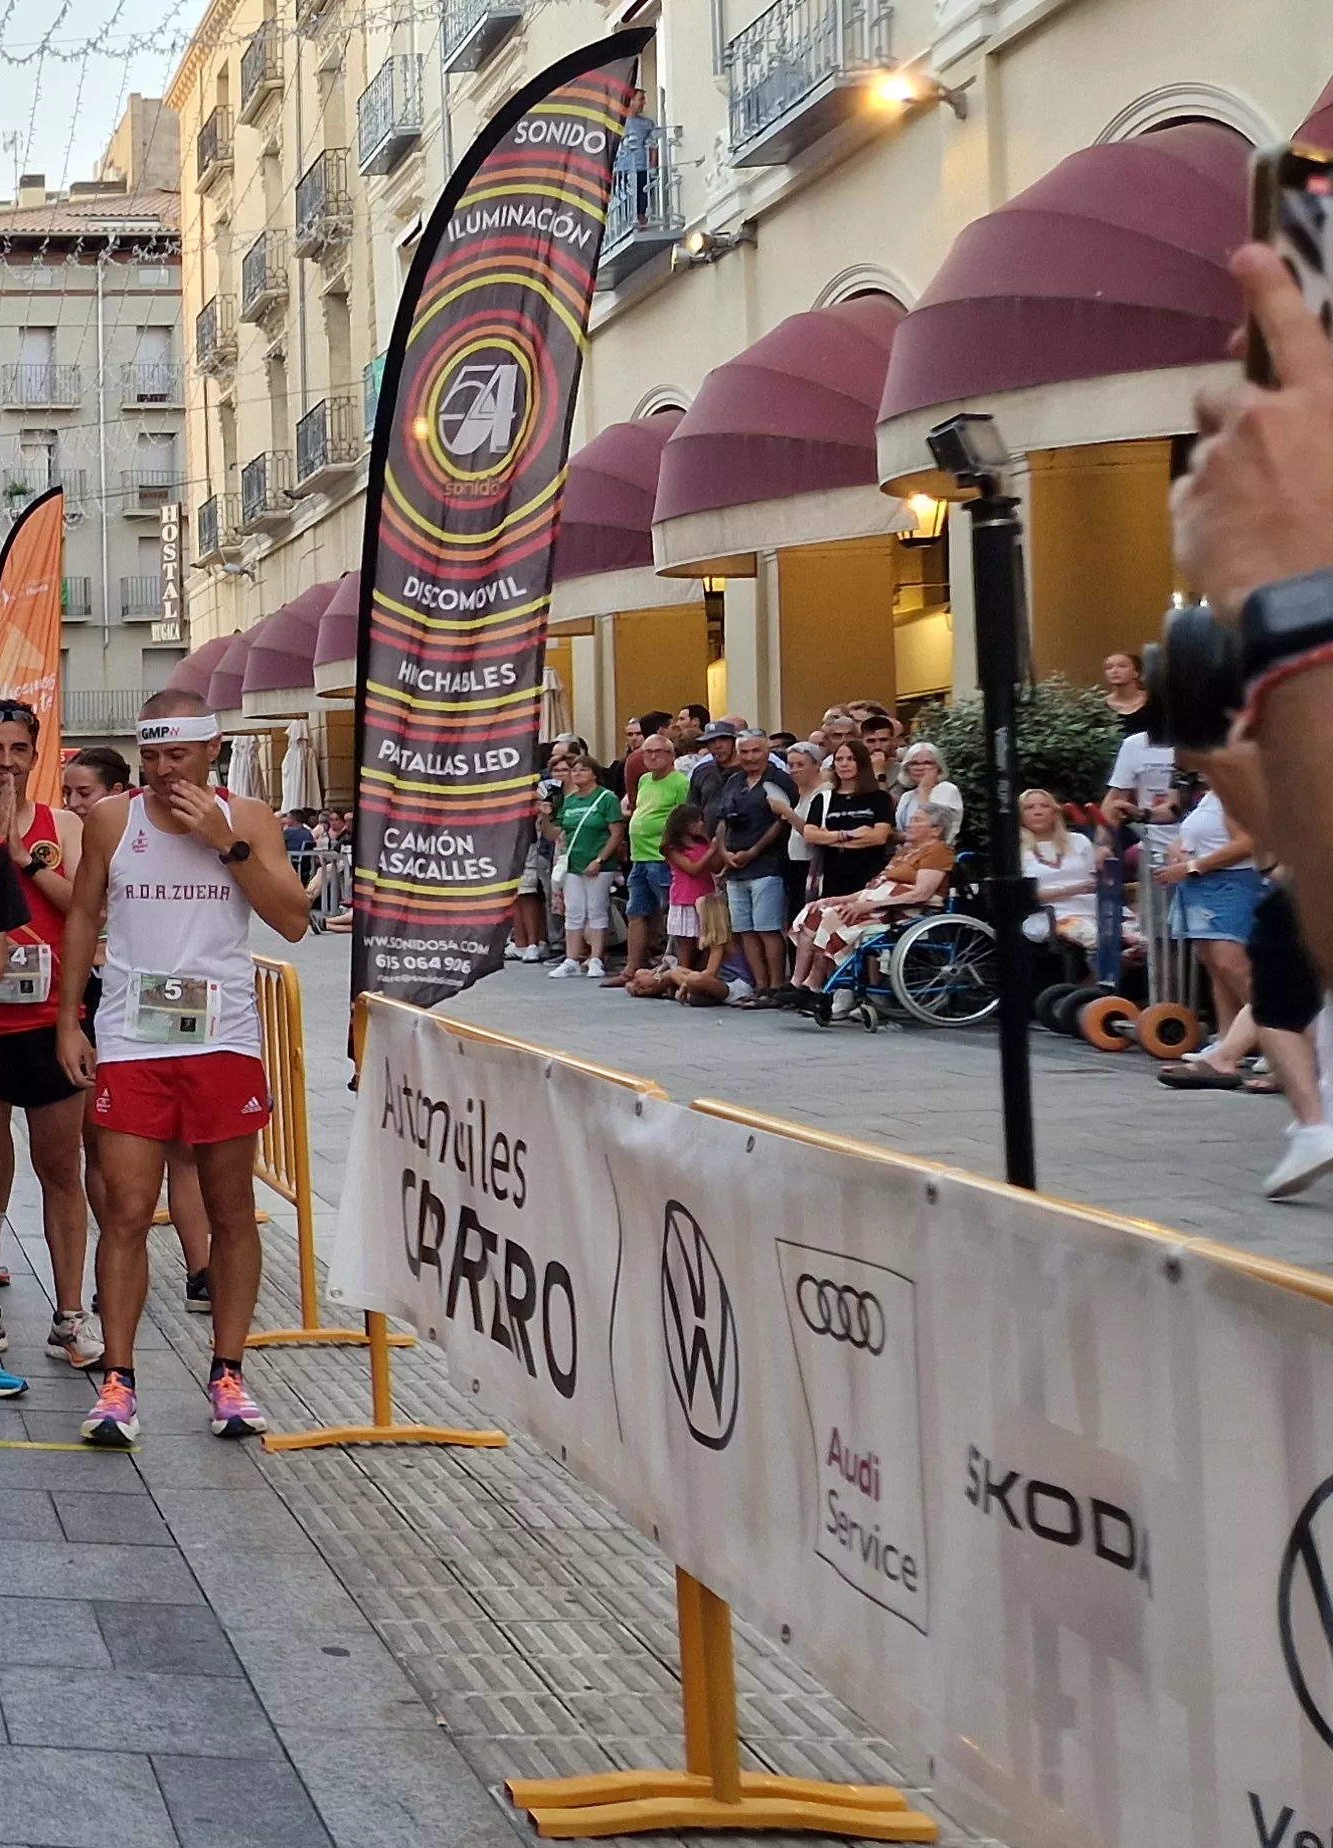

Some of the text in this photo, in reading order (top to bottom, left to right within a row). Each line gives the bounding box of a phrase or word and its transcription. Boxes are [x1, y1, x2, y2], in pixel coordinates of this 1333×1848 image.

[514, 120, 606, 154] SONIDO
[448, 205, 592, 250] ILUMINACIÓN
[439, 364, 518, 455] 54
[161, 505, 178, 618] HOSTAL
[403, 576, 527, 611] DISCOMOVIL
[474, 747, 520, 774] LED
[384, 829, 475, 856] CAMIÓN
[10, 946, 28, 967] 4
[376, 953, 400, 970] 615
[403, 955, 442, 970] 064
[164, 978, 183, 1000] 5
[826, 1427, 881, 1502] Audi
[825, 1489, 918, 1593] Service
